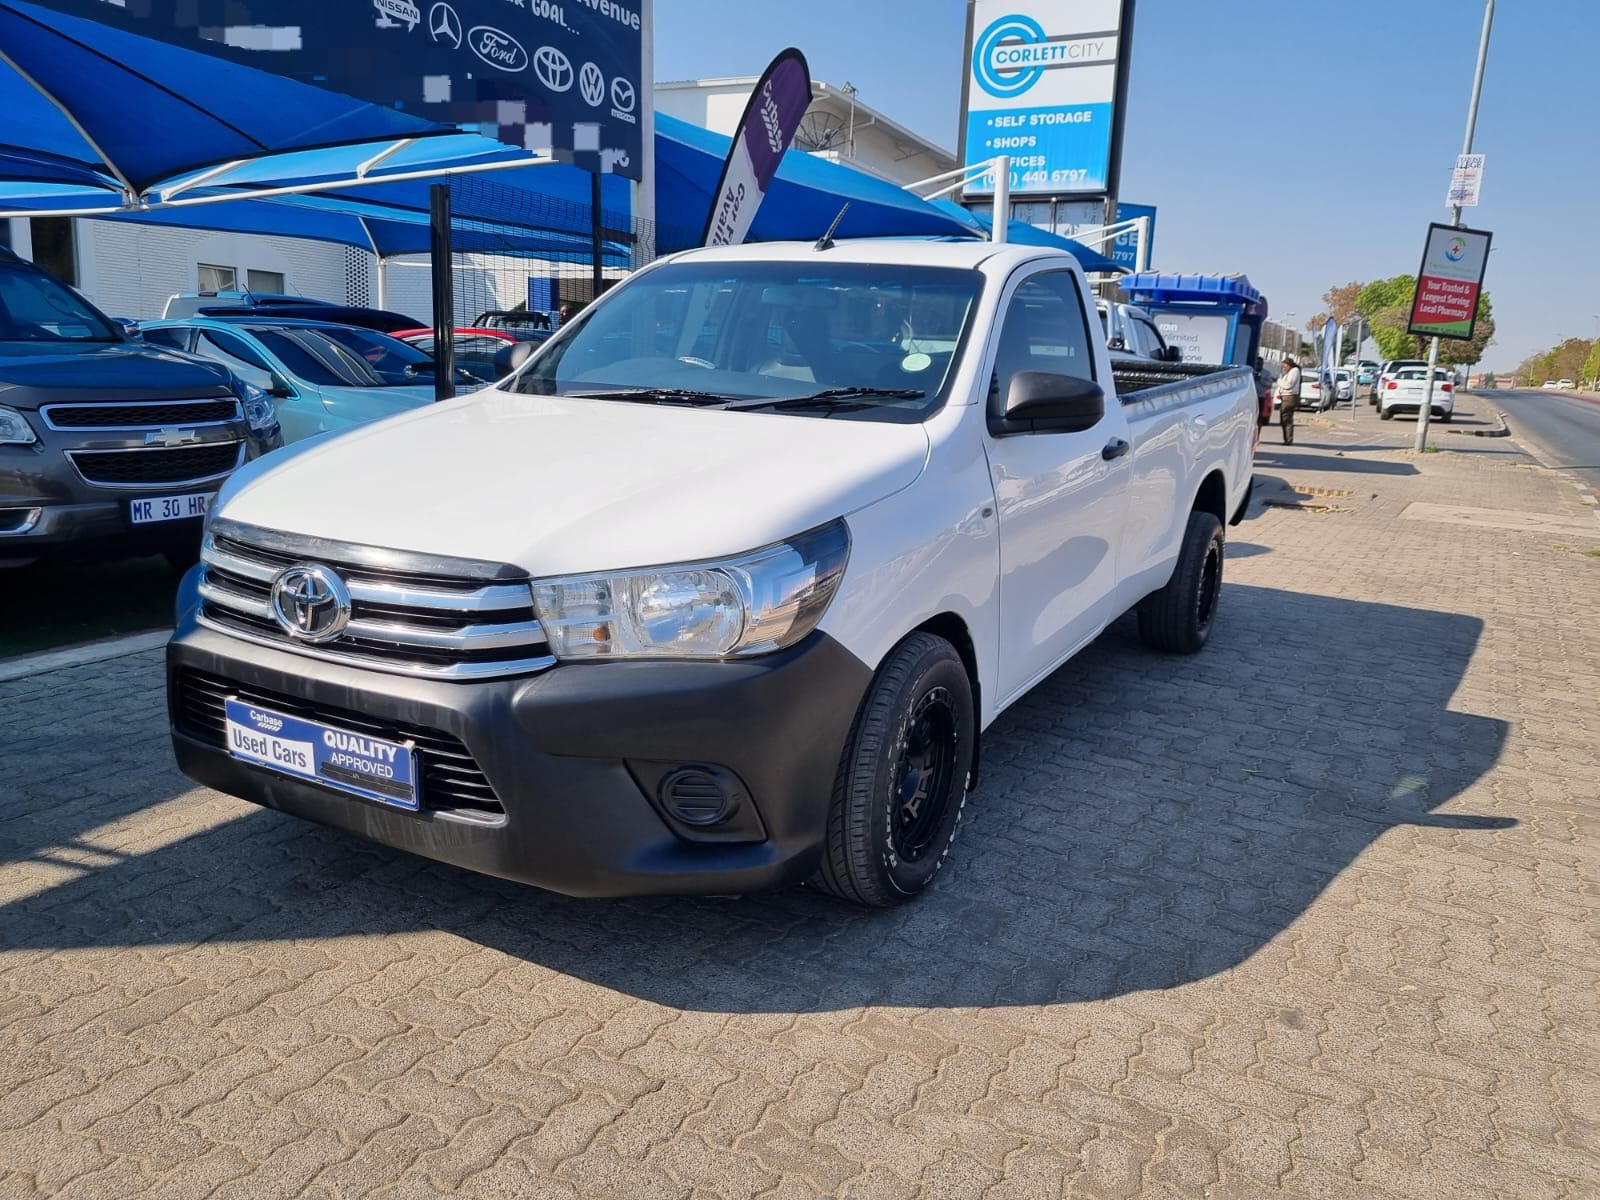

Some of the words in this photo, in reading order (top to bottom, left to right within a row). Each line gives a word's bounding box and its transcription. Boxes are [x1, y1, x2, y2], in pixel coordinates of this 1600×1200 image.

[376, 0, 418, 19] NISSAN
[480, 32, 518, 65] Ford
[994, 114, 1027, 128] SELF
[1029, 110, 1093, 126] STORAGE
[993, 135, 1037, 149] SHOPS
[1009, 155, 1046, 168] FICES
[982, 171, 1019, 187] (01)
[1022, 170, 1049, 183] 440
[1051, 168, 1088, 182] 6797
[1420, 303, 1438, 314] Local
[1163, 334, 1199, 343] nlimited
[132, 501, 153, 521] MR
[162, 498, 180, 518] 30
[188, 496, 206, 515] HR
[250, 710, 283, 728] Carbase
[232, 727, 267, 756] Used
[272, 742, 307, 768] Cars
[323, 731, 397, 763] QUALITY
[330, 752, 394, 778] APPROVED
